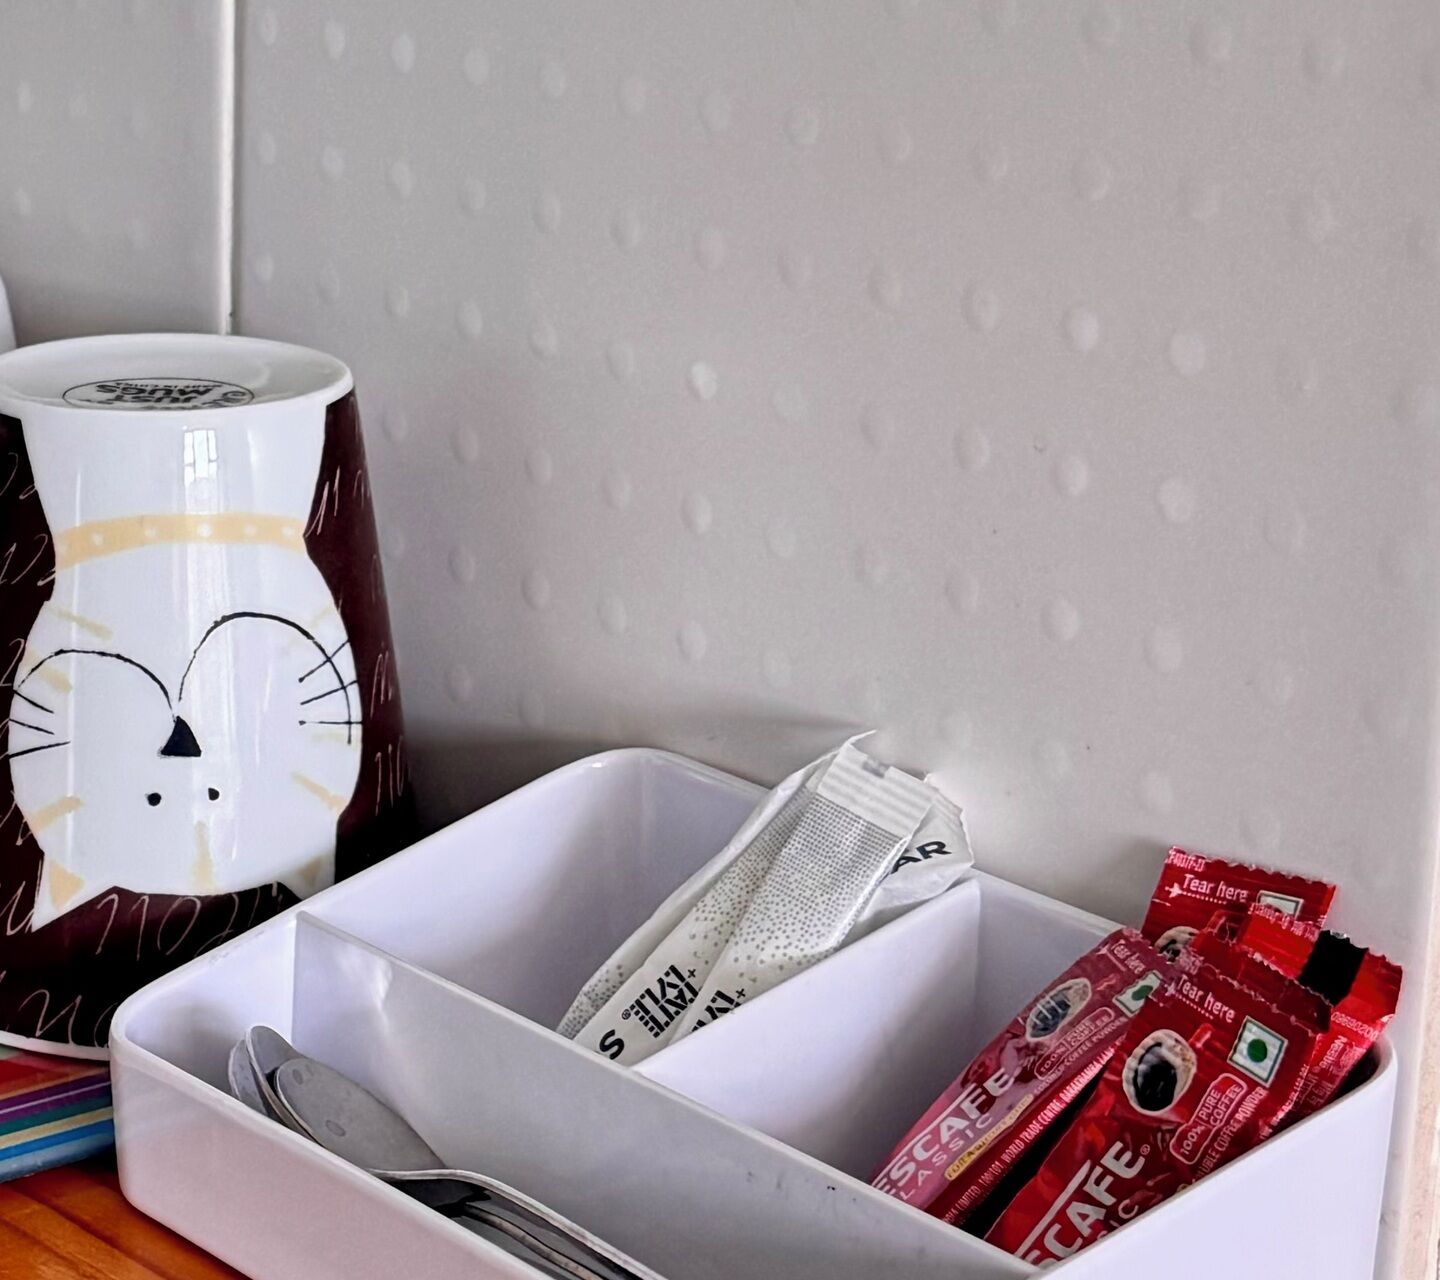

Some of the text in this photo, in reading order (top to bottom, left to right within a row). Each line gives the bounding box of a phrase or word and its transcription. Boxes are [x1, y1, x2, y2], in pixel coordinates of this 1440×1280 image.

[96, 384, 214, 397] MUGS
[110, 394, 198, 404] JUST
[1182, 873, 1249, 903] Tear here
[643, 980, 700, 1039] TATE
[1177, 974, 1236, 1023] Tear here
[1198, 1087, 1222, 1120] PURE
[1209, 1083, 1243, 1128] COFFEE
[875, 1067, 1015, 1197] ESCAFE
[1002, 1139, 1026, 1166] WORLD
[1020, 1120, 1044, 1146] TRADE
[1179, 1123, 1206, 1156] 100%
[900, 1113, 994, 1201] LASSIC
